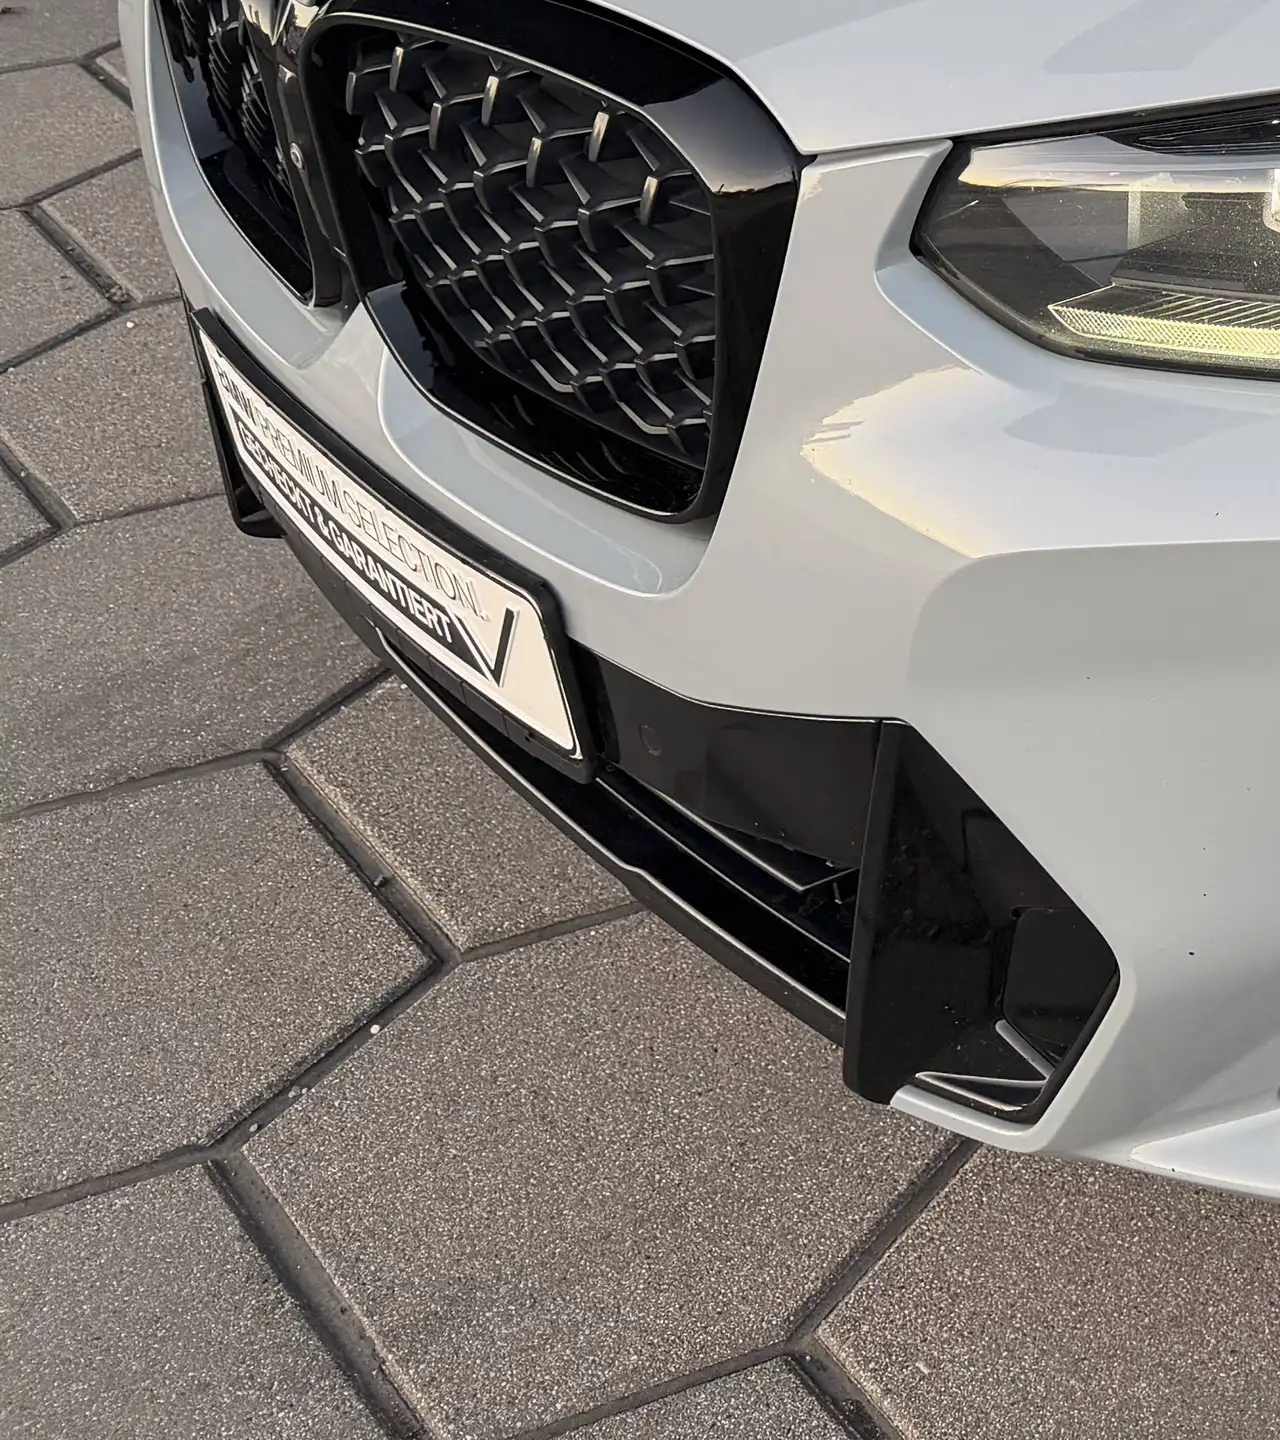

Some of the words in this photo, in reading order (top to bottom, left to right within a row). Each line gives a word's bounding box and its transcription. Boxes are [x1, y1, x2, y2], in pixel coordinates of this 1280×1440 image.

[213, 359, 257, 427] BMW
[253, 406, 343, 514] PREMIUM
[314, 506, 331, 540] &
[328, 520, 453, 644] GARANTIERT
